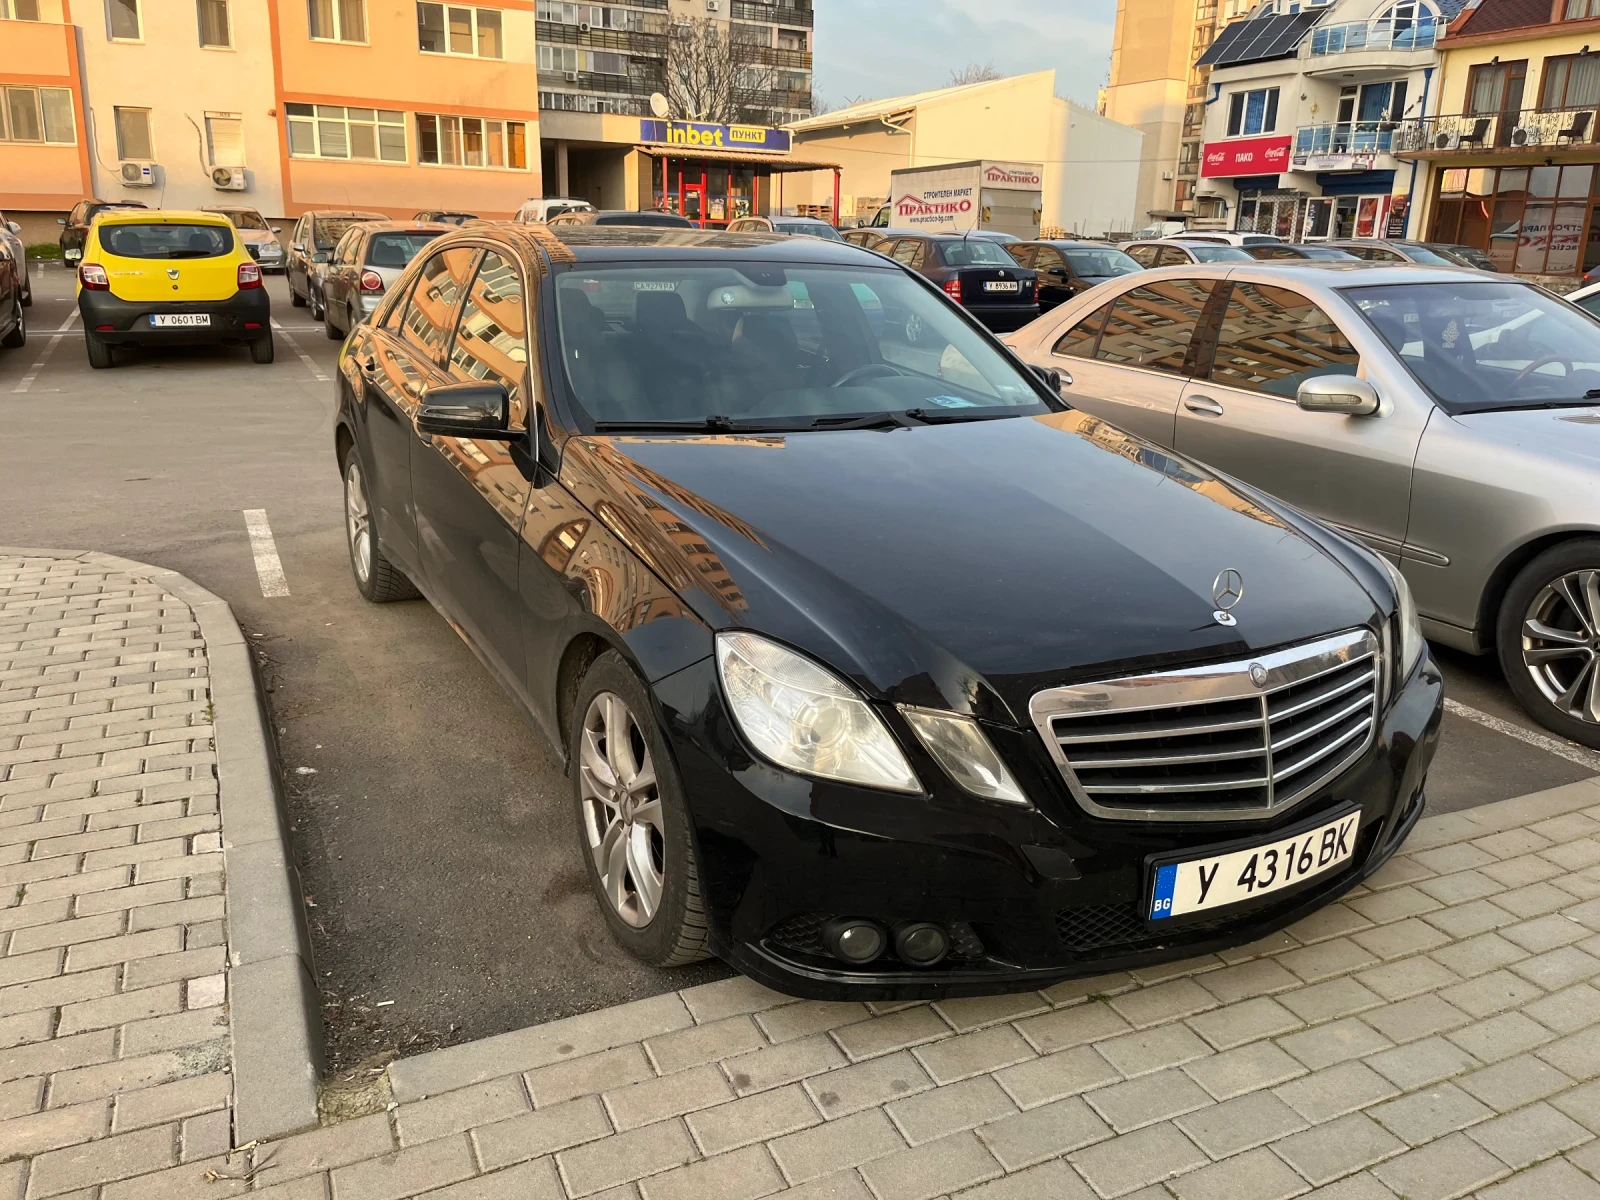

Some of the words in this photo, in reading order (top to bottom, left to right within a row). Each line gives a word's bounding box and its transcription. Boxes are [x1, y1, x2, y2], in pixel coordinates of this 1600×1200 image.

[666, 121, 723, 147] inbet
[731, 130, 763, 141] ПУНКТ
[1235, 152, 1254, 163] ПАКО
[923, 190, 953, 199] СТРОИТЕЛЕН
[953, 188, 973, 197] МАРКЕТ
[898, 199, 972, 216] ПРАКТИКО
[909, 215, 954, 224] www.practico-bg.com
[1153, 898, 1171, 912] BG
